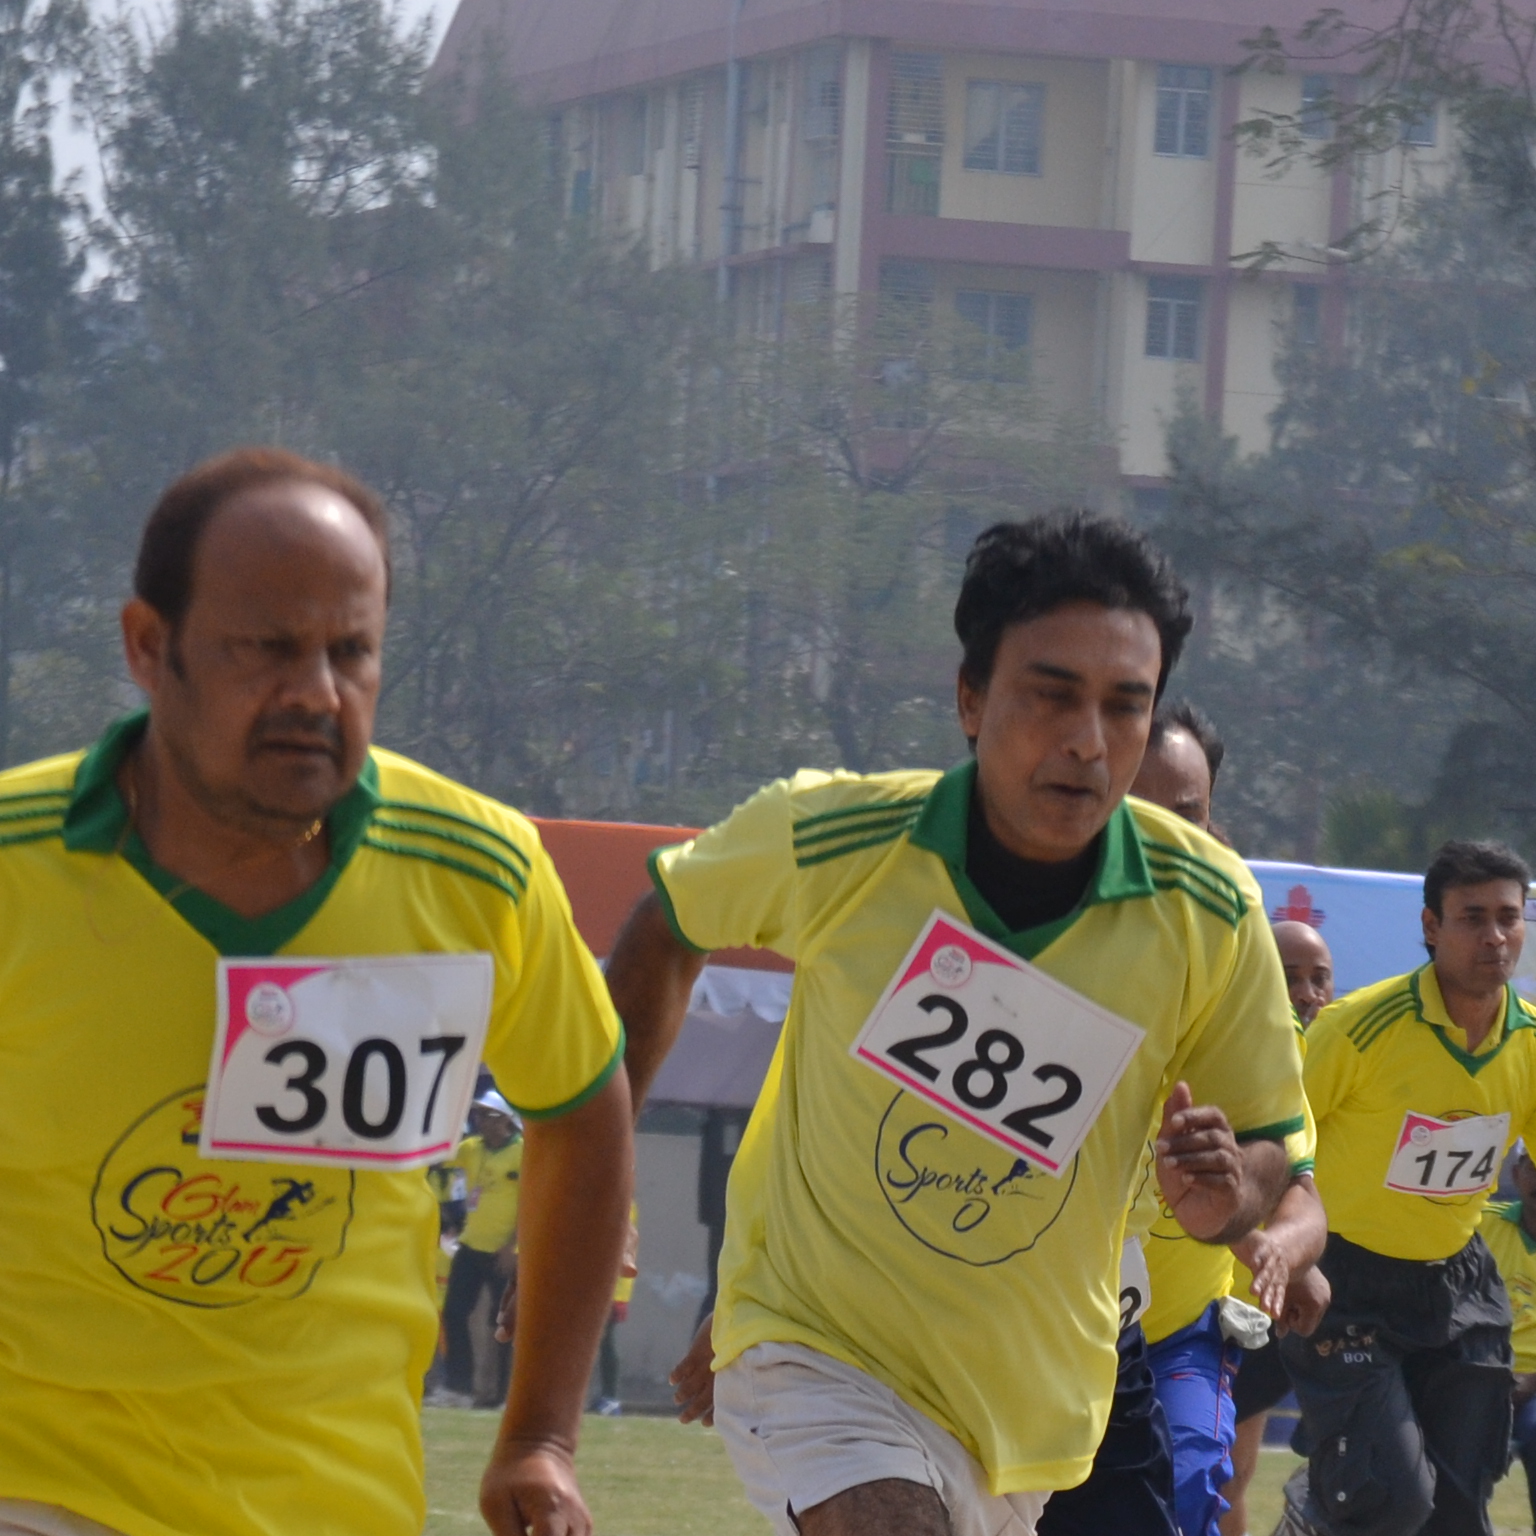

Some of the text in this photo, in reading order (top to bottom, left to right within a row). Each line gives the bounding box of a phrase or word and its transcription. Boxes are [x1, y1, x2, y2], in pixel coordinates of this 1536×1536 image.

[255, 1036, 466, 1142] 307
[885, 994, 1083, 1150] 282
[886, 1122, 989, 1204] Sports
[1415, 1146, 1497, 1188] 174
[109, 1166, 237, 1259] Sports
[144, 1245, 311, 1288] 2015
